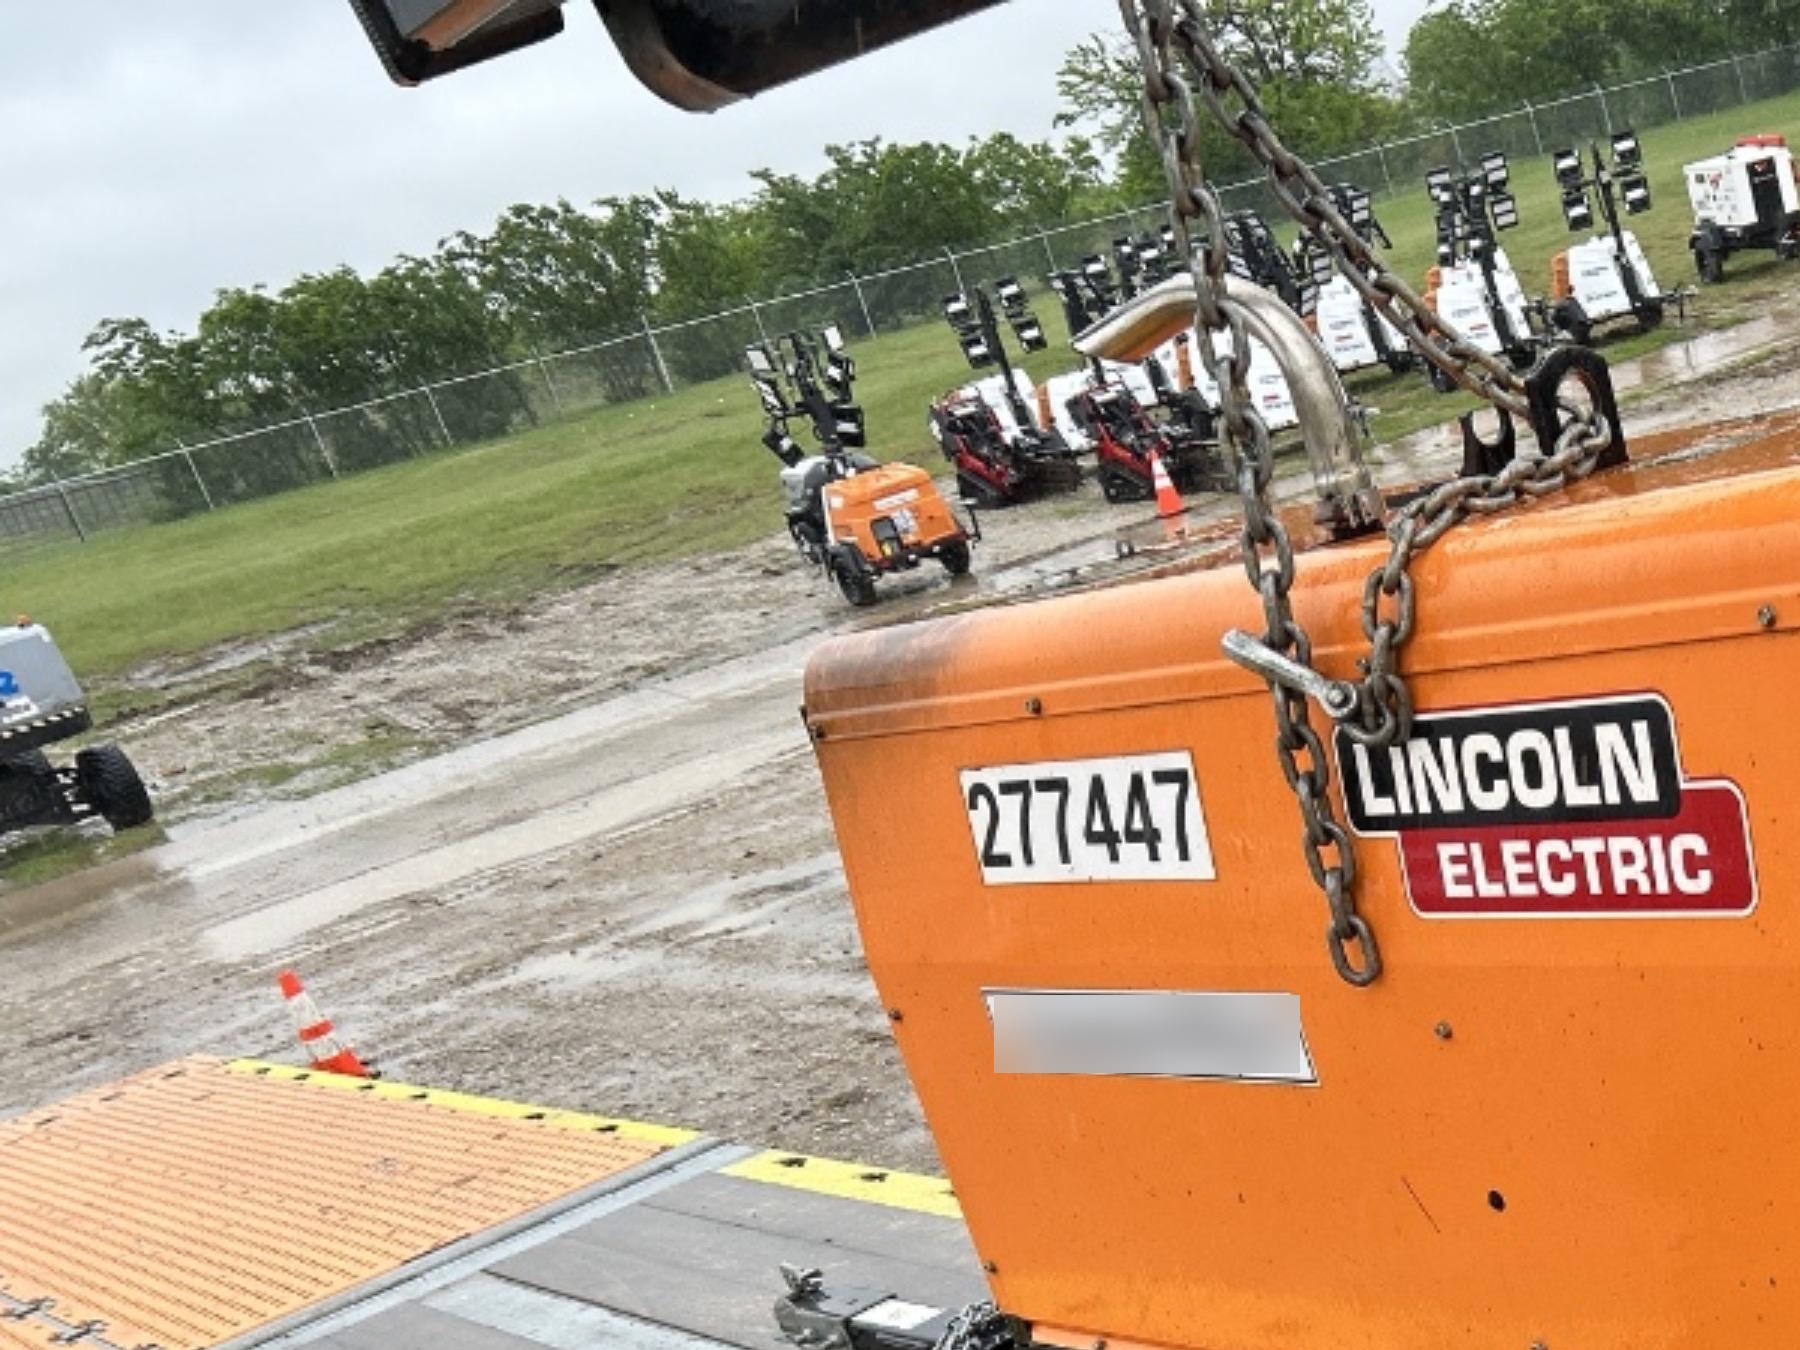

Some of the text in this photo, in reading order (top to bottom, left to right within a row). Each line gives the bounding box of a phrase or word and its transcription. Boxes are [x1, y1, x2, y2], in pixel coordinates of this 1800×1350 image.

[1352, 718, 1661, 817] LINCOLN
[967, 767, 1192, 868] 277447
[1435, 833, 1713, 898] ELECTRIC
